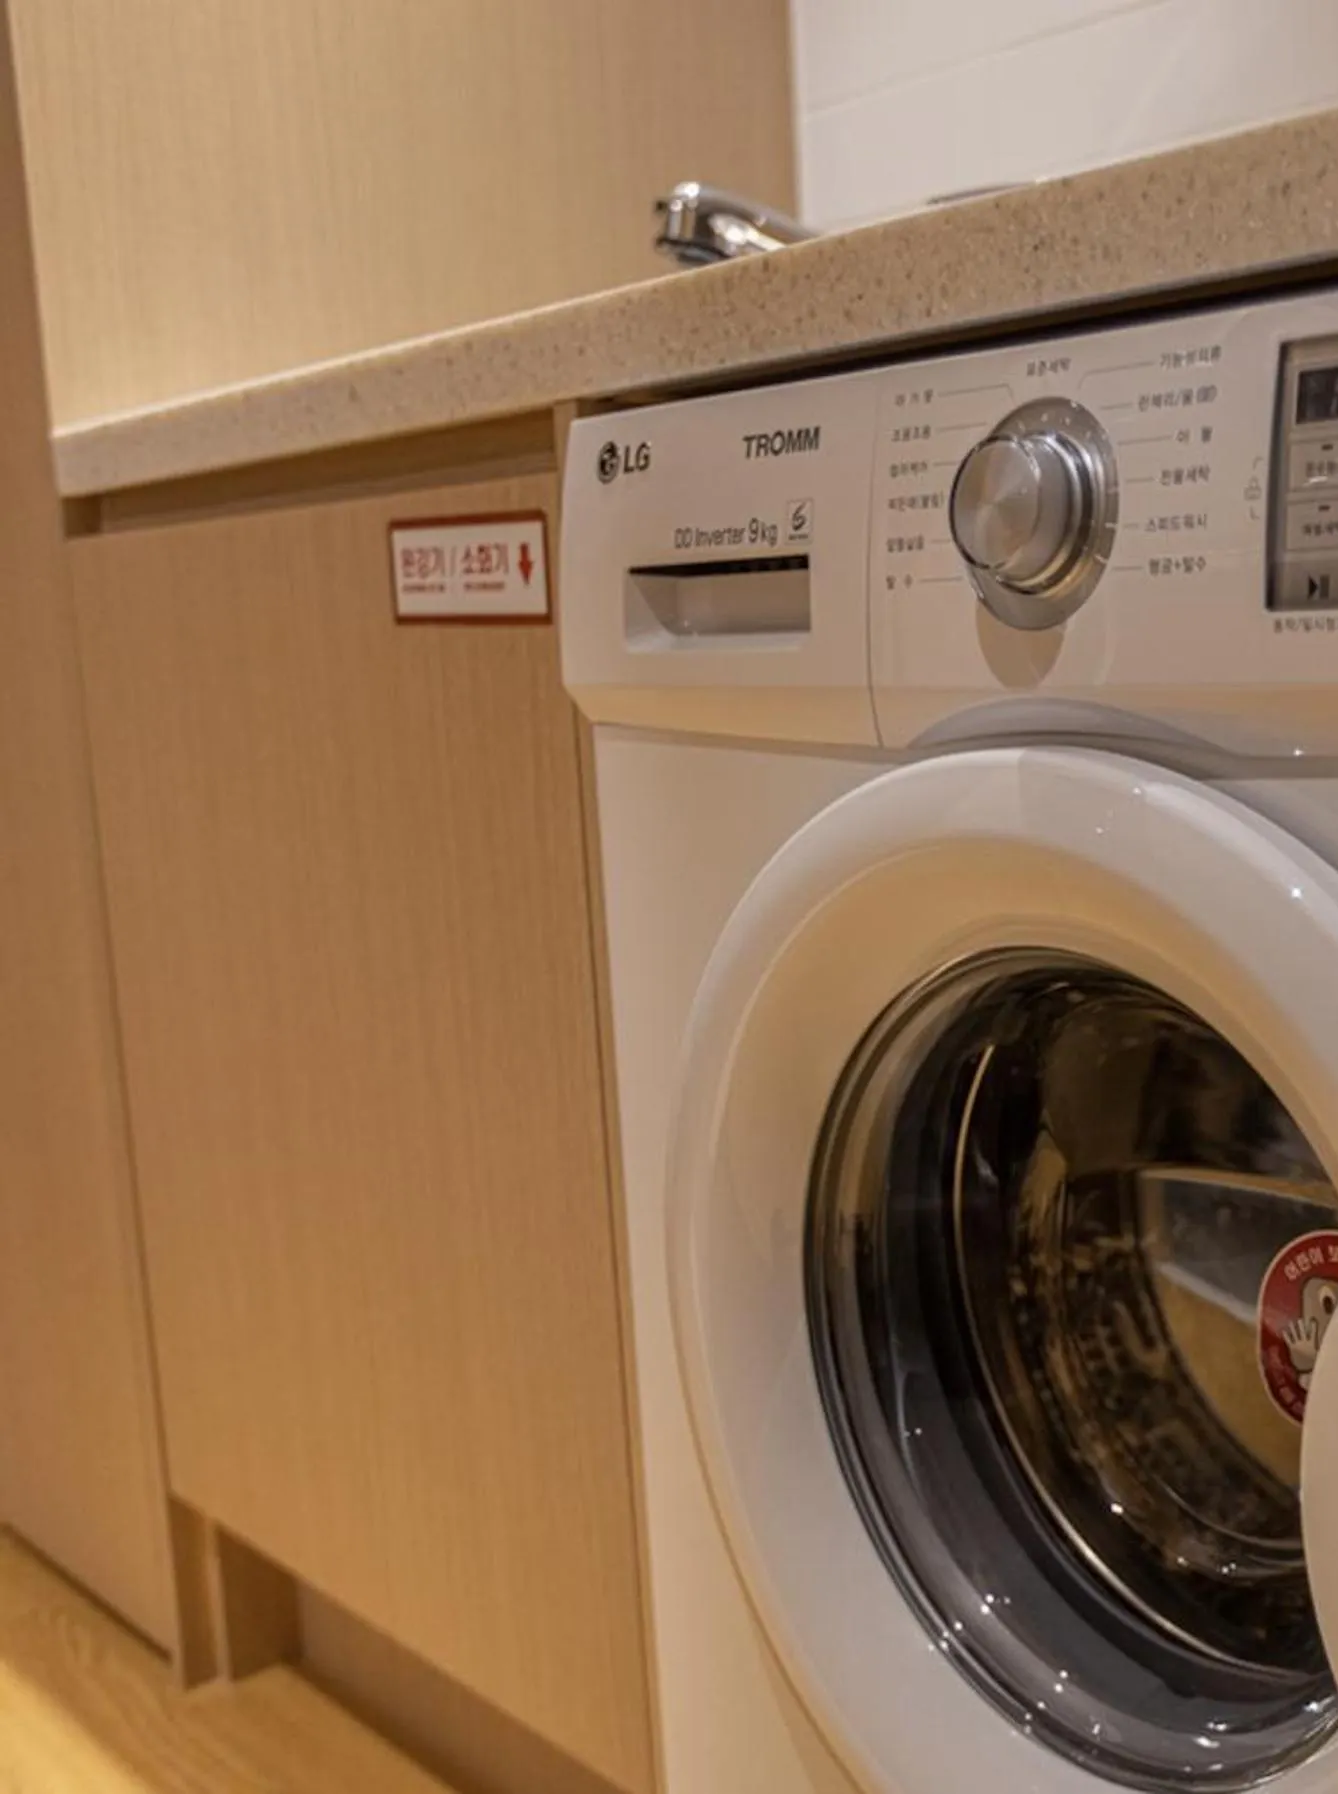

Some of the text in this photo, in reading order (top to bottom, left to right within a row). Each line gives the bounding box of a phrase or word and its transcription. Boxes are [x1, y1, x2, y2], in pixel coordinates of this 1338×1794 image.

[623, 441, 651, 474] LG
[742, 425, 822, 459] TROMM
[695, 525, 745, 547] Inverter
